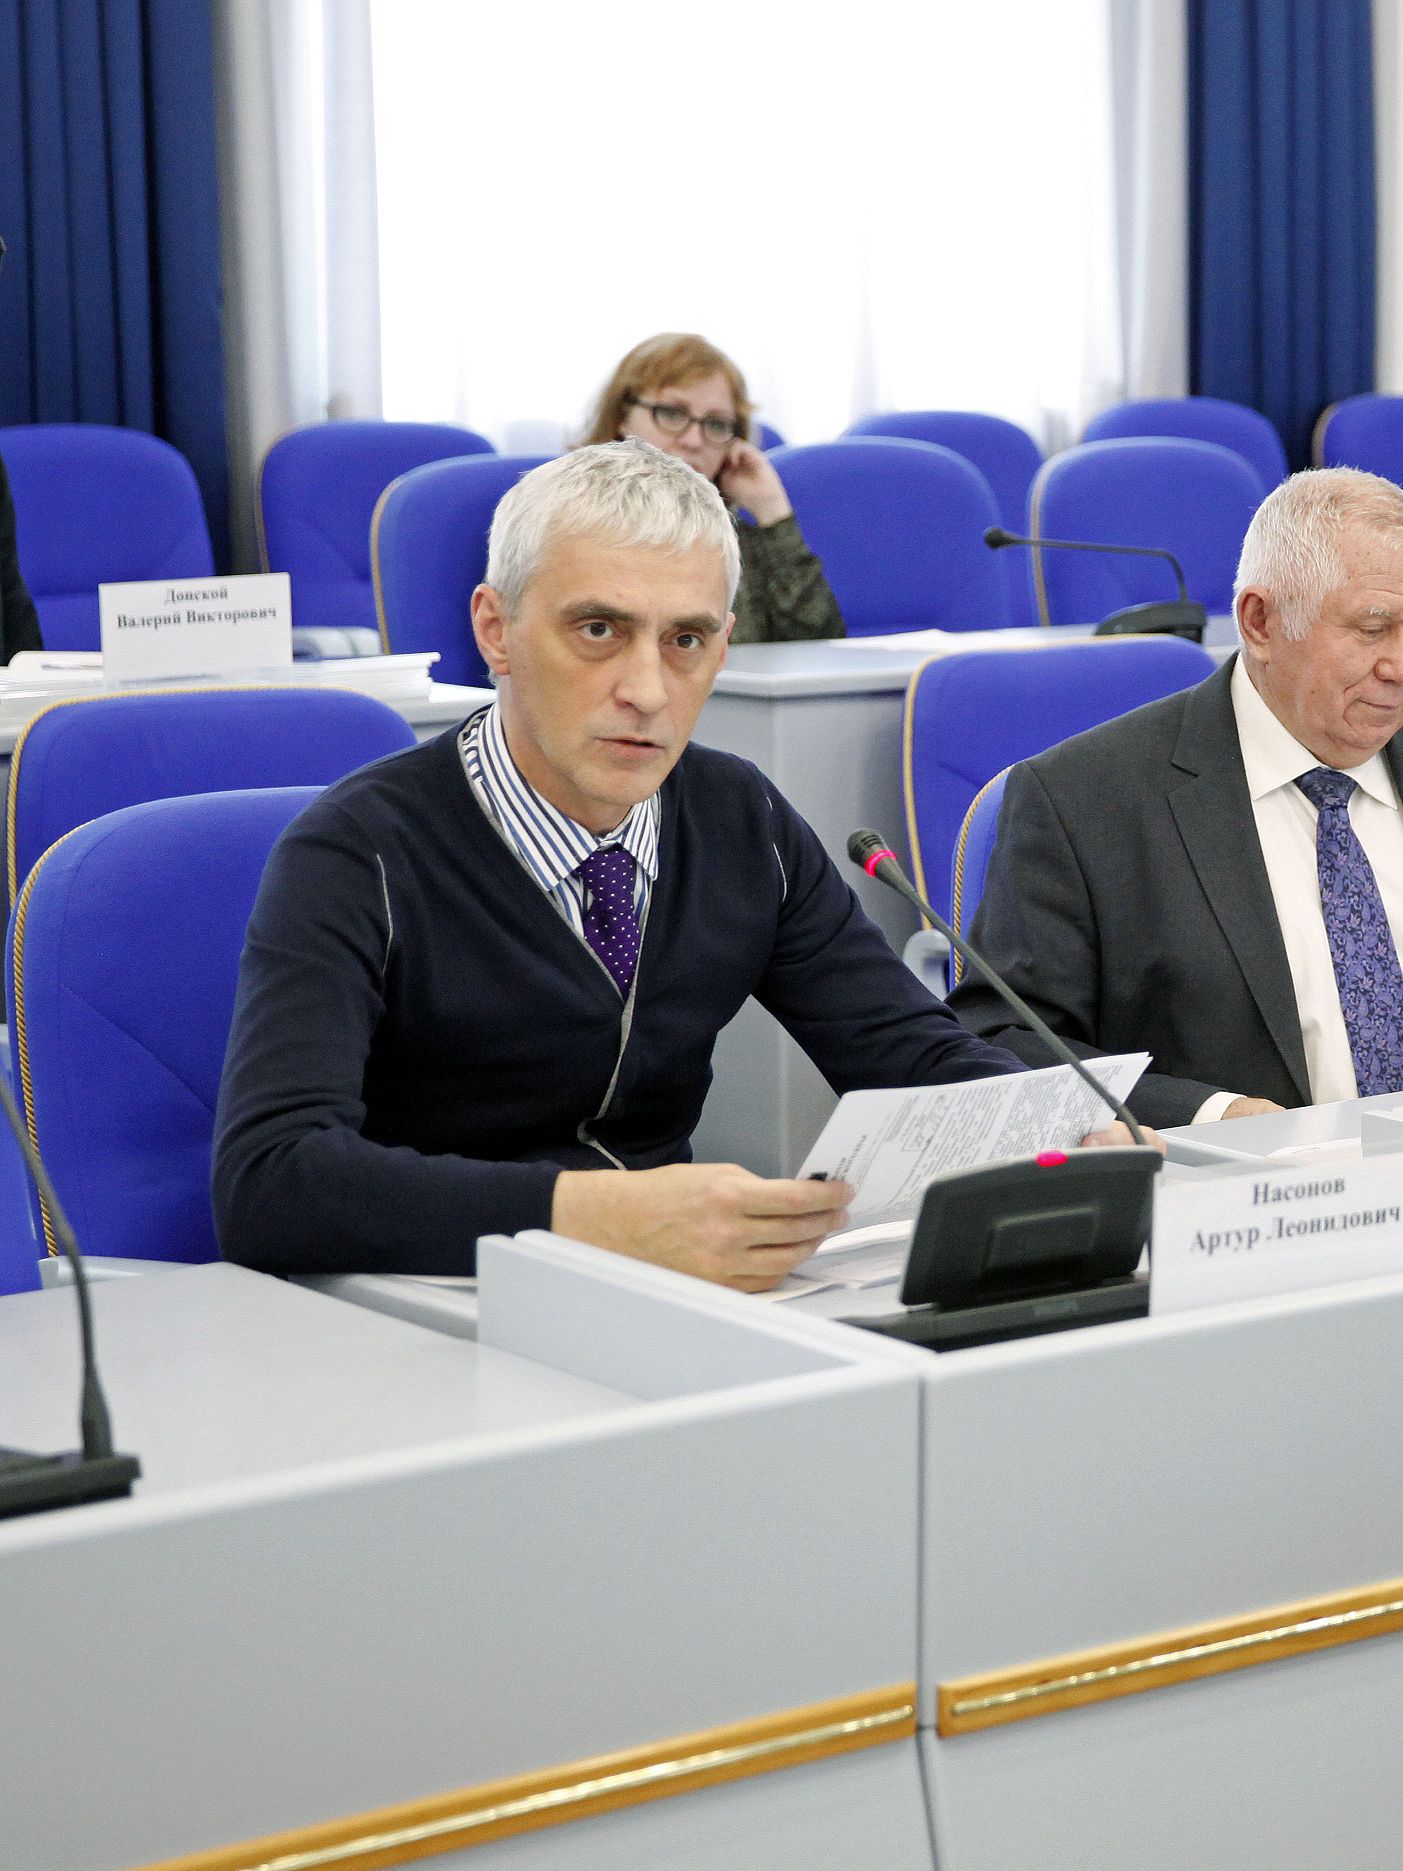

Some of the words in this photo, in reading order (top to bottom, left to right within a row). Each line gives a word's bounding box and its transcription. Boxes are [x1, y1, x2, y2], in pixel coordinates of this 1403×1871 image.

[164, 585, 229, 605] Донской
[117, 611, 181, 630] Валерий
[186, 606, 277, 624] Викторович
[1252, 1177, 1346, 1205] Насонов
[1191, 1226, 1260, 1255] Артур
[1265, 1206, 1401, 1240] Леонидович
